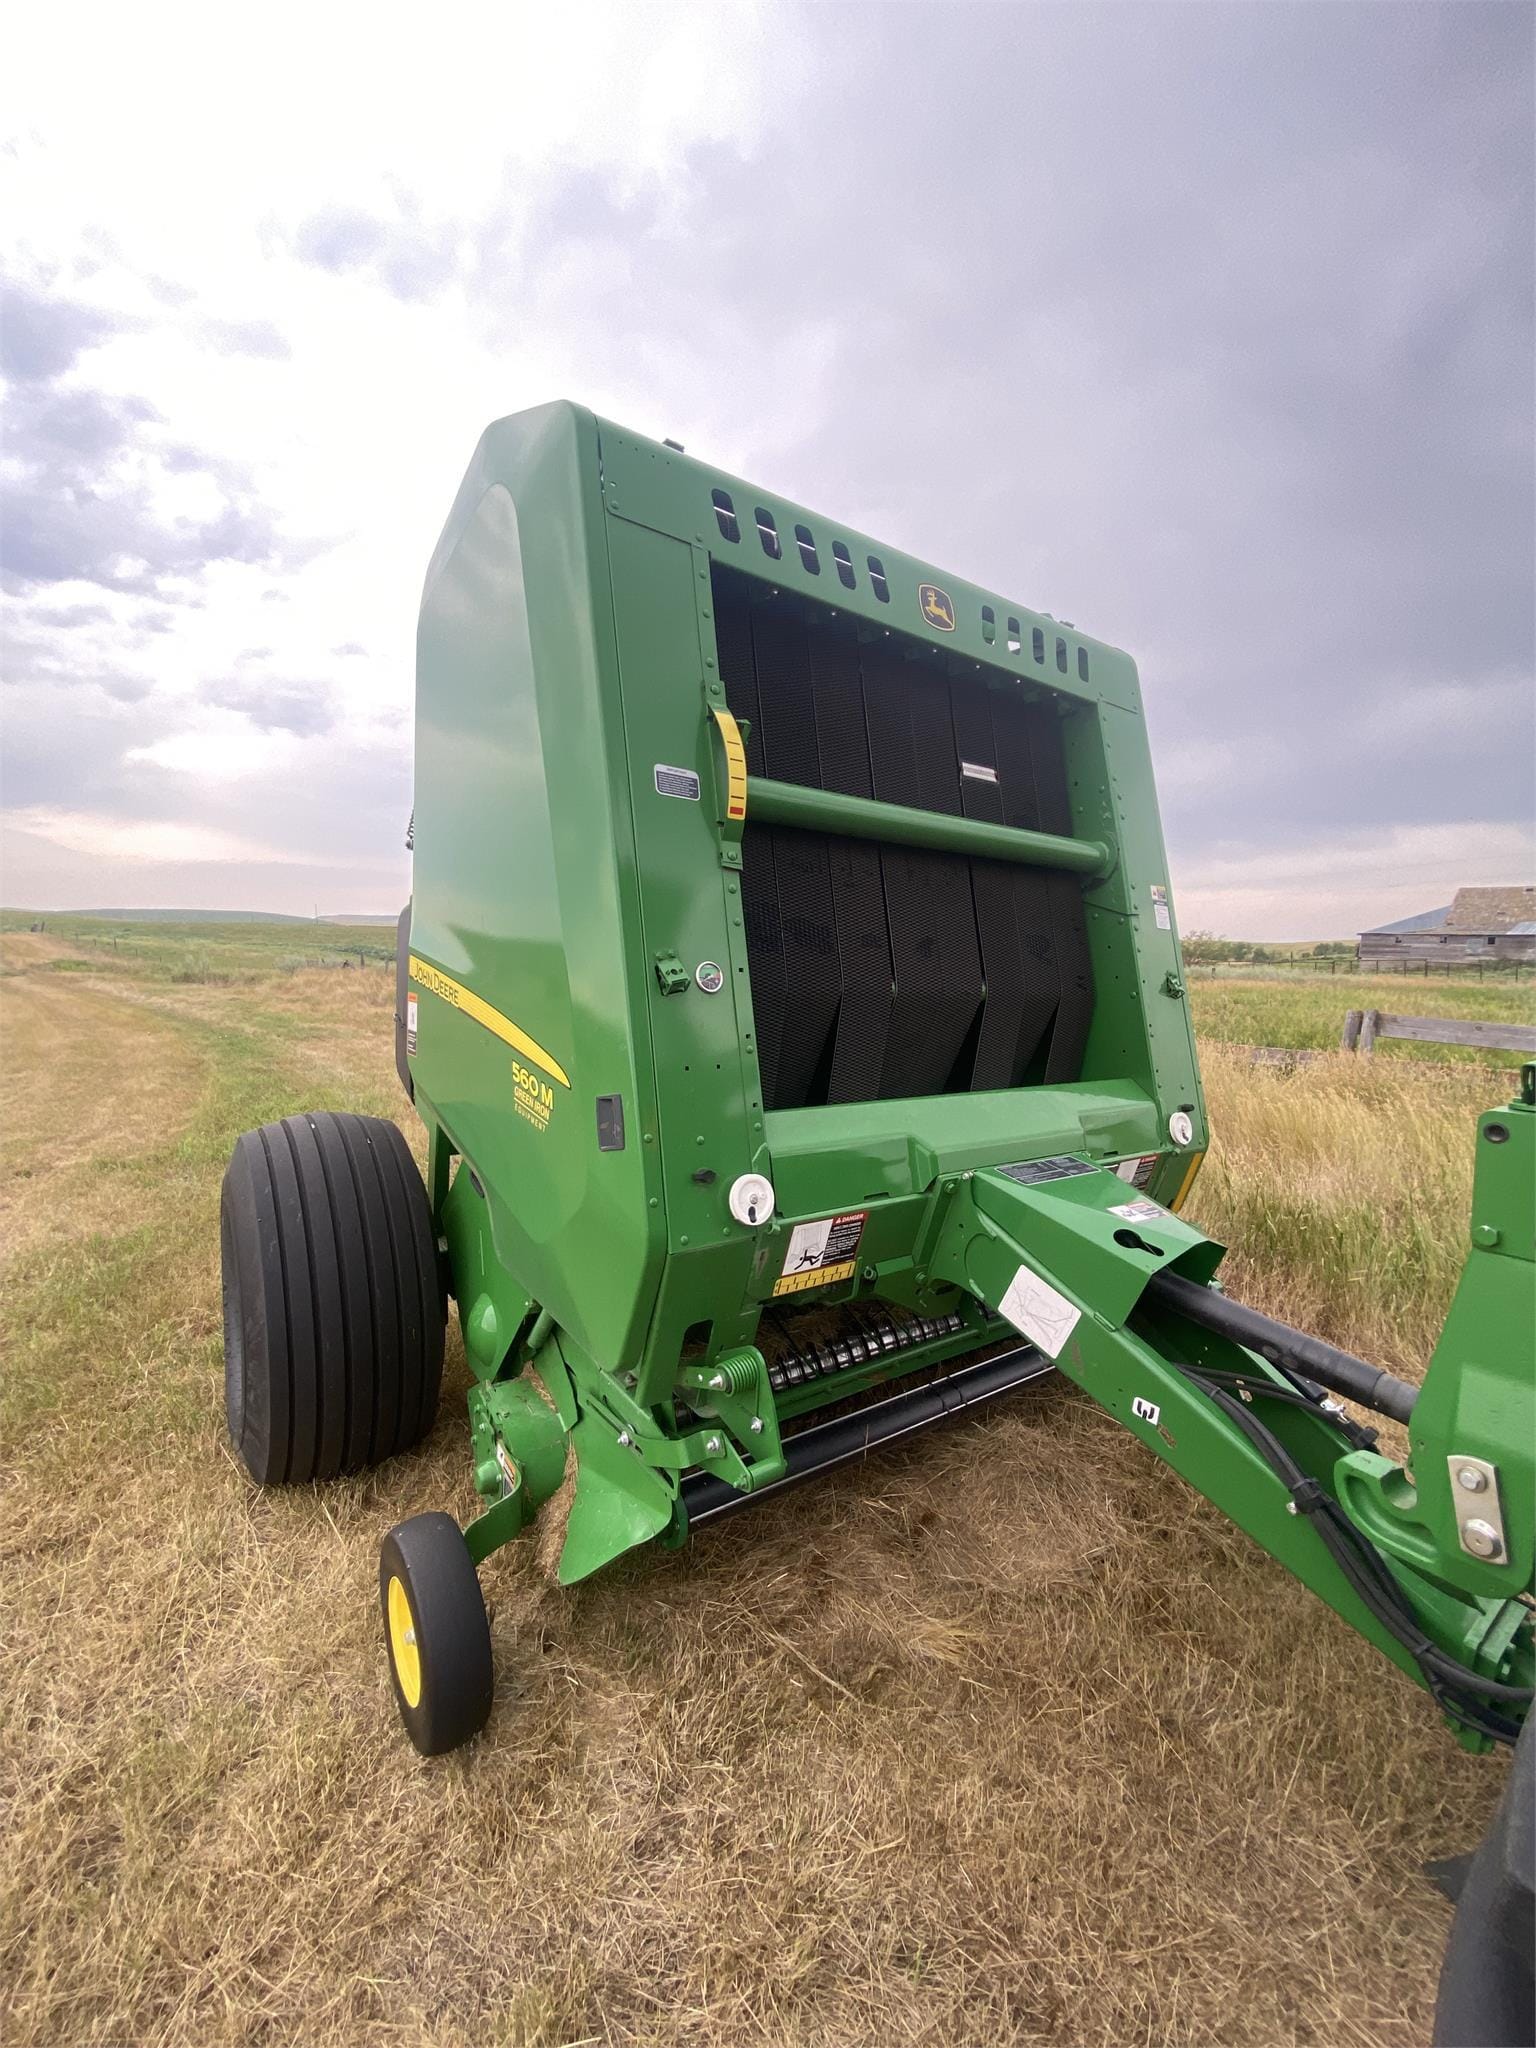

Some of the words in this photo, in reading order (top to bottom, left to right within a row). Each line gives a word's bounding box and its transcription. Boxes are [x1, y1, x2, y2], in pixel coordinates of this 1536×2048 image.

[414, 963, 433, 990] JOHN
[433, 973, 459, 1005] DEERE
[513, 1061, 539, 1097] 560
[541, 1082, 554, 1110] M
[514, 1103, 546, 1132] EQUIPMENT
[515, 1086, 534, 1108] GREEN
[534, 1101, 550, 1120] IRON
[842, 1213, 864, 1222] DANGER
